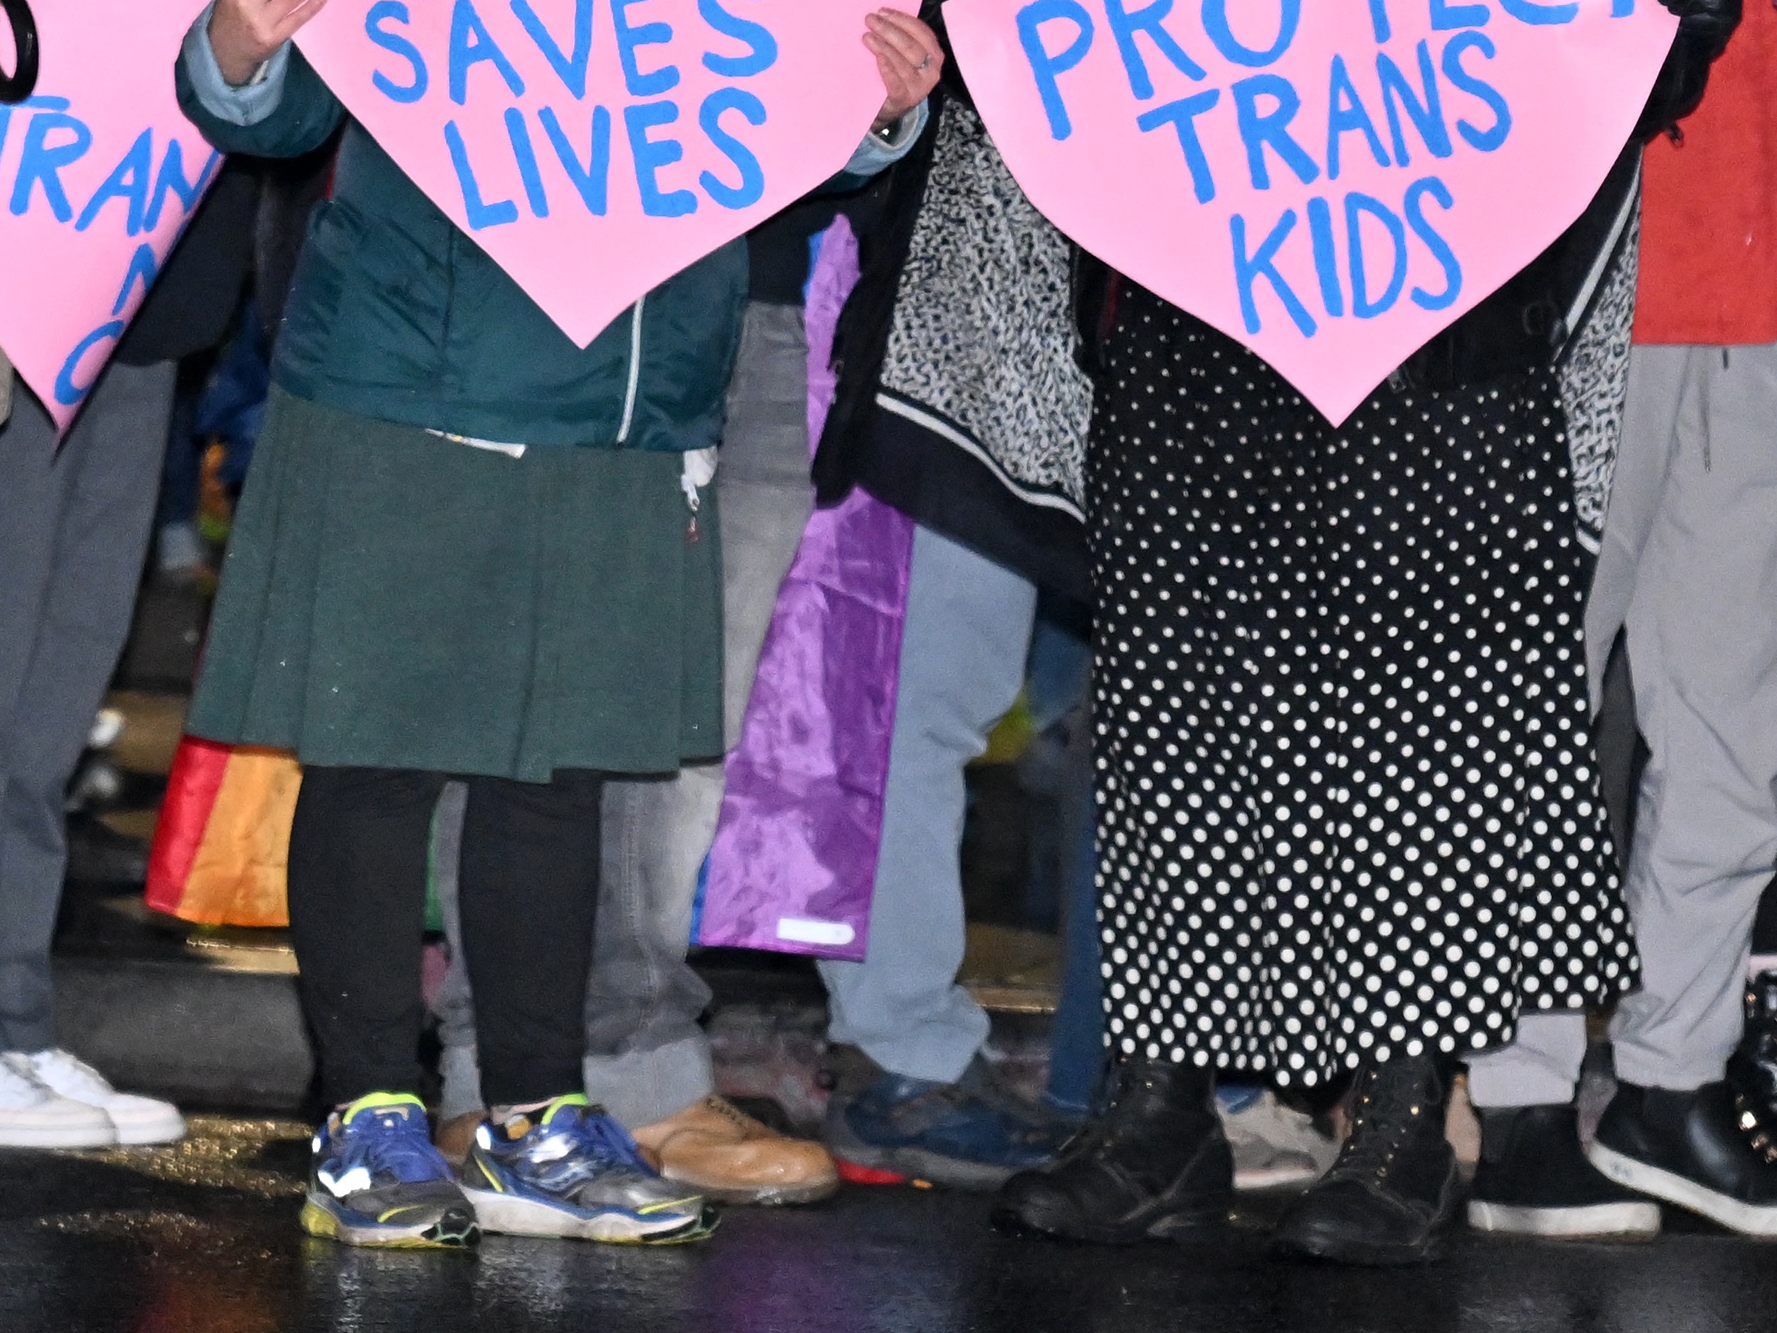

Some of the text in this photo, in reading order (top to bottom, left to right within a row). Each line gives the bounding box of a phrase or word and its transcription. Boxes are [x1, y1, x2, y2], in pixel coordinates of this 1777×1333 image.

[443, 85, 770, 232] LIVES
[1135, 29, 1513, 206] TRANS
[1228, 174, 1464, 339] KIDS
